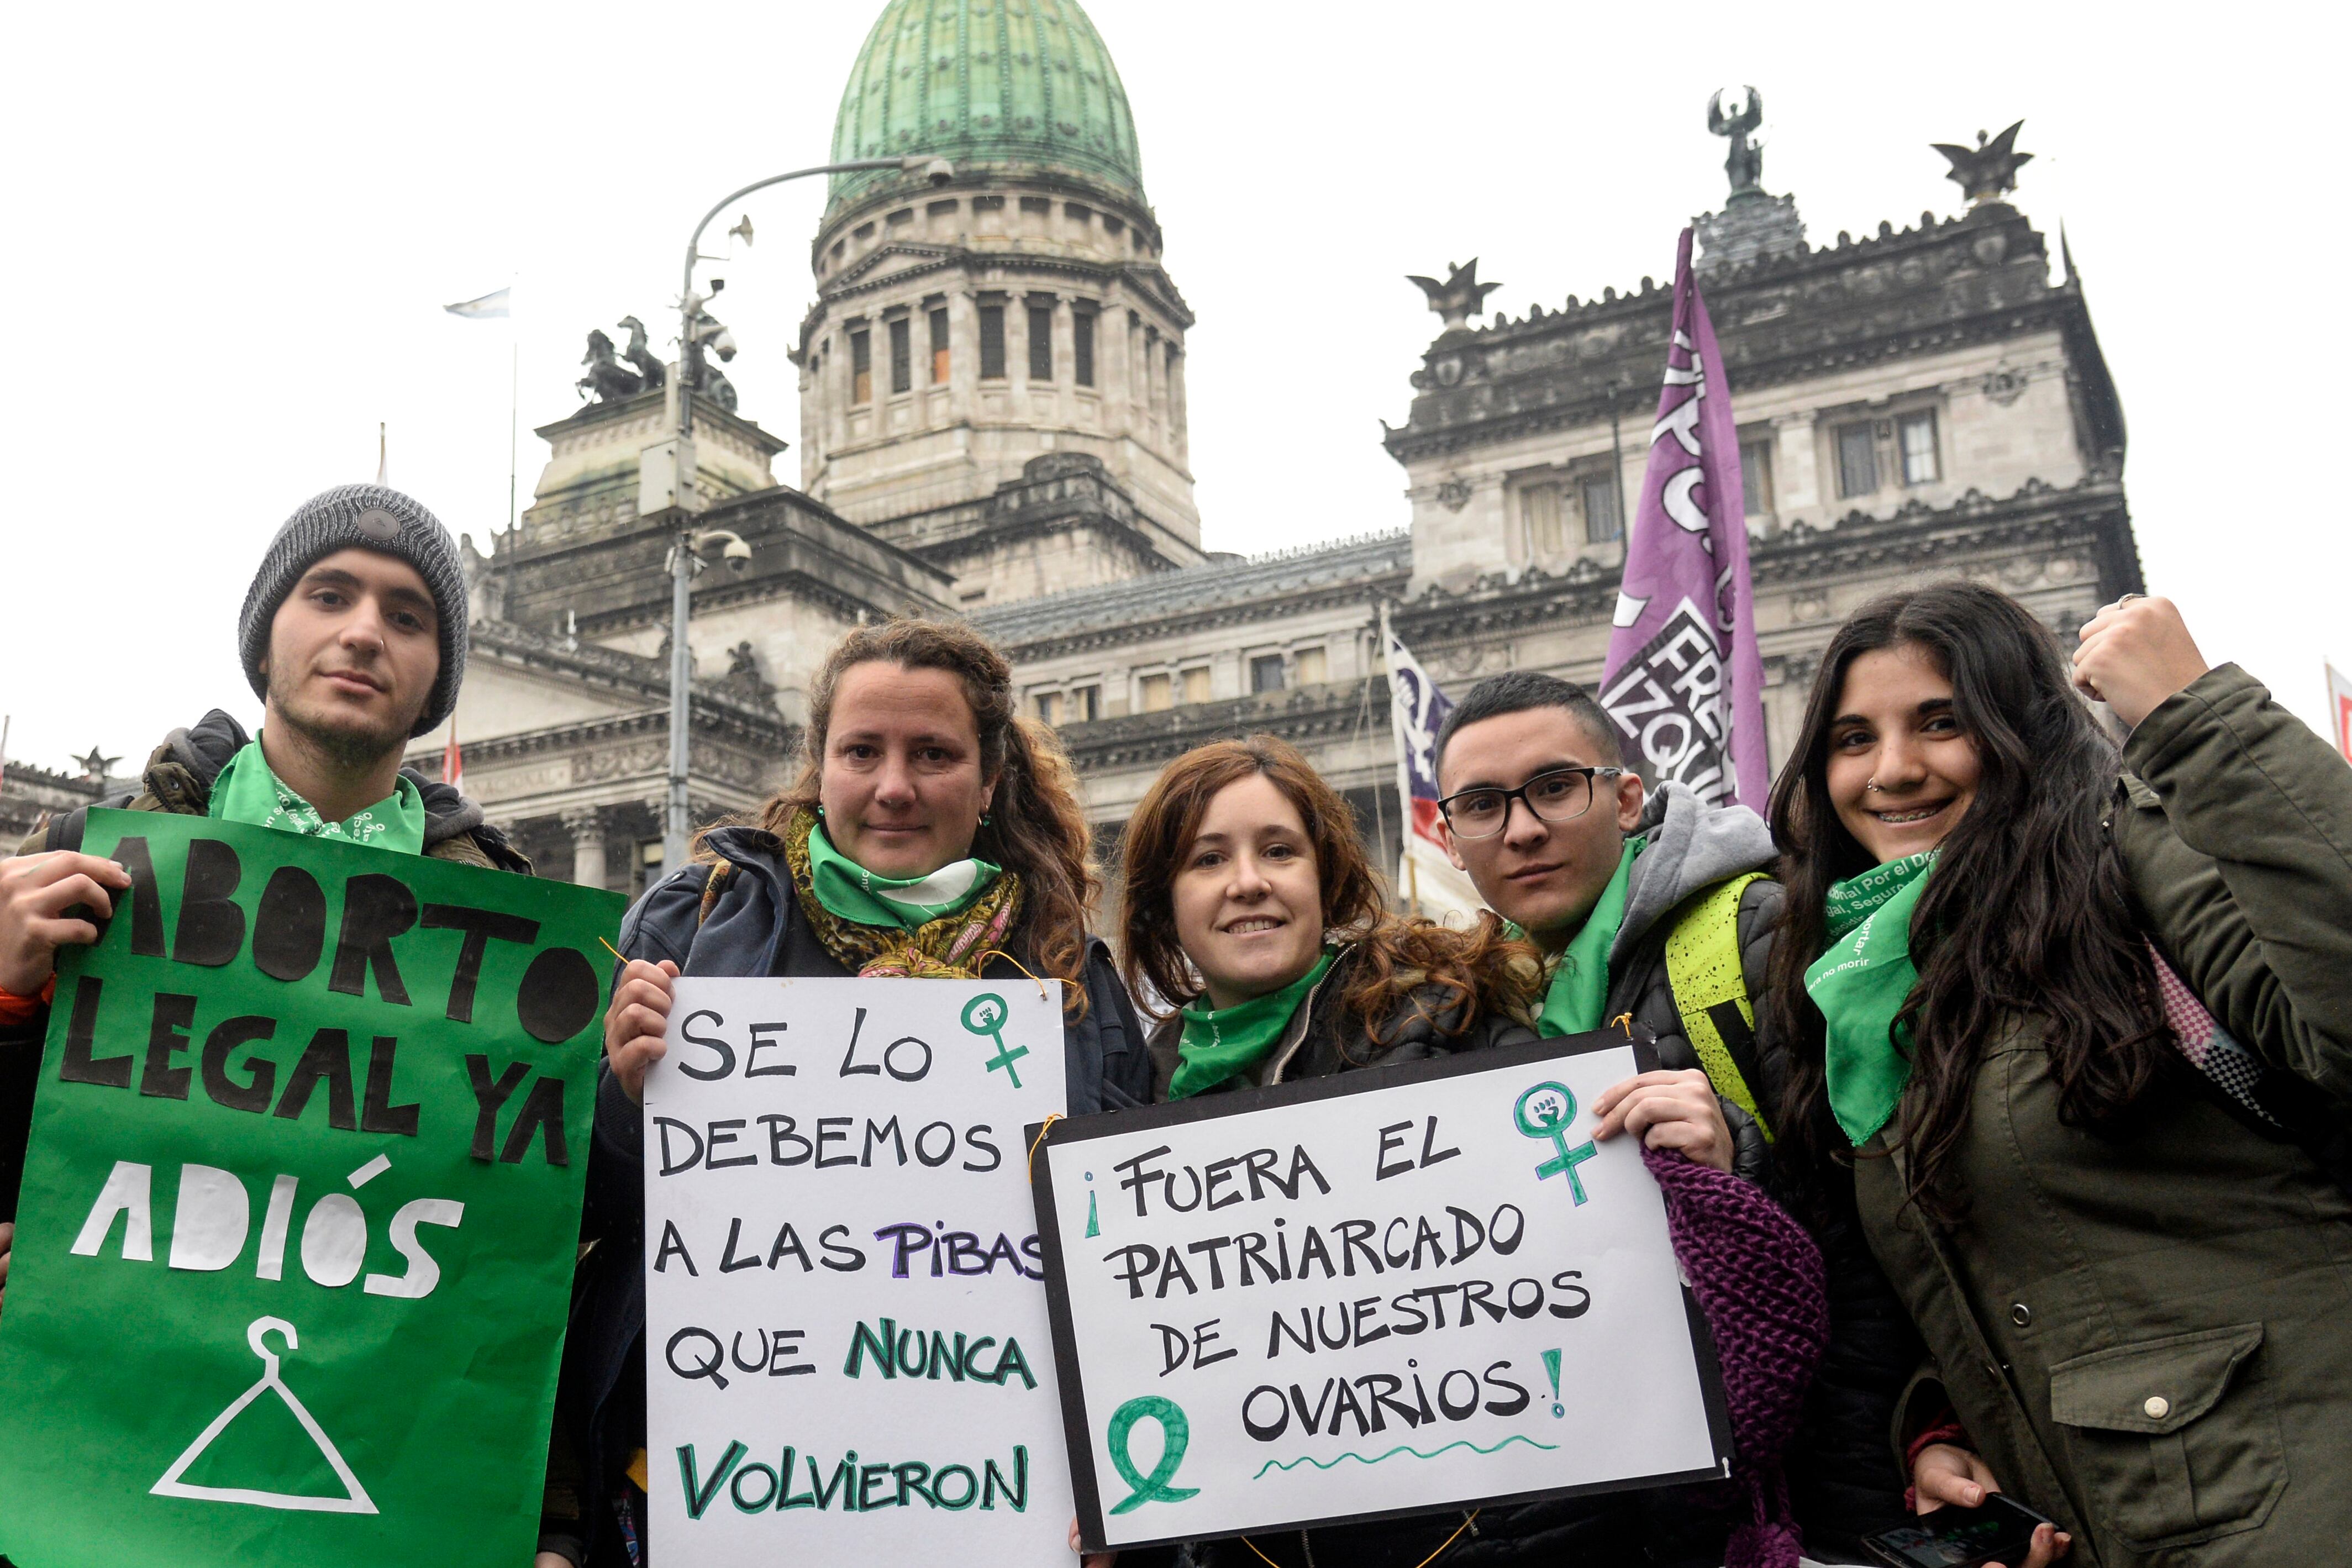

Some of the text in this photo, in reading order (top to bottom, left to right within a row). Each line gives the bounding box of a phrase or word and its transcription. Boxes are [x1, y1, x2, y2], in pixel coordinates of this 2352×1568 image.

[1861, 870, 1890, 891] Por
[1893, 860, 1910, 876] el
[94, 836, 600, 1043] ABORTO
[1823, 968, 1835, 979] no
[1837, 957, 1870, 972] morir
[60, 976, 569, 1166] LEGAL YA
[678, 1007, 933, 1082] SE LO
[653, 1113, 1002, 1177] DEBEMOS
[1375, 1116, 1461, 1181] EL
[70, 1154, 465, 1299] ADIÓS
[653, 1219, 699, 1277] A
[719, 1217, 866, 1274] LAS
[665, 1317, 1038, 1391] QUE NUNCA
[1150, 1270, 1592, 1378] DE NUESTROS
